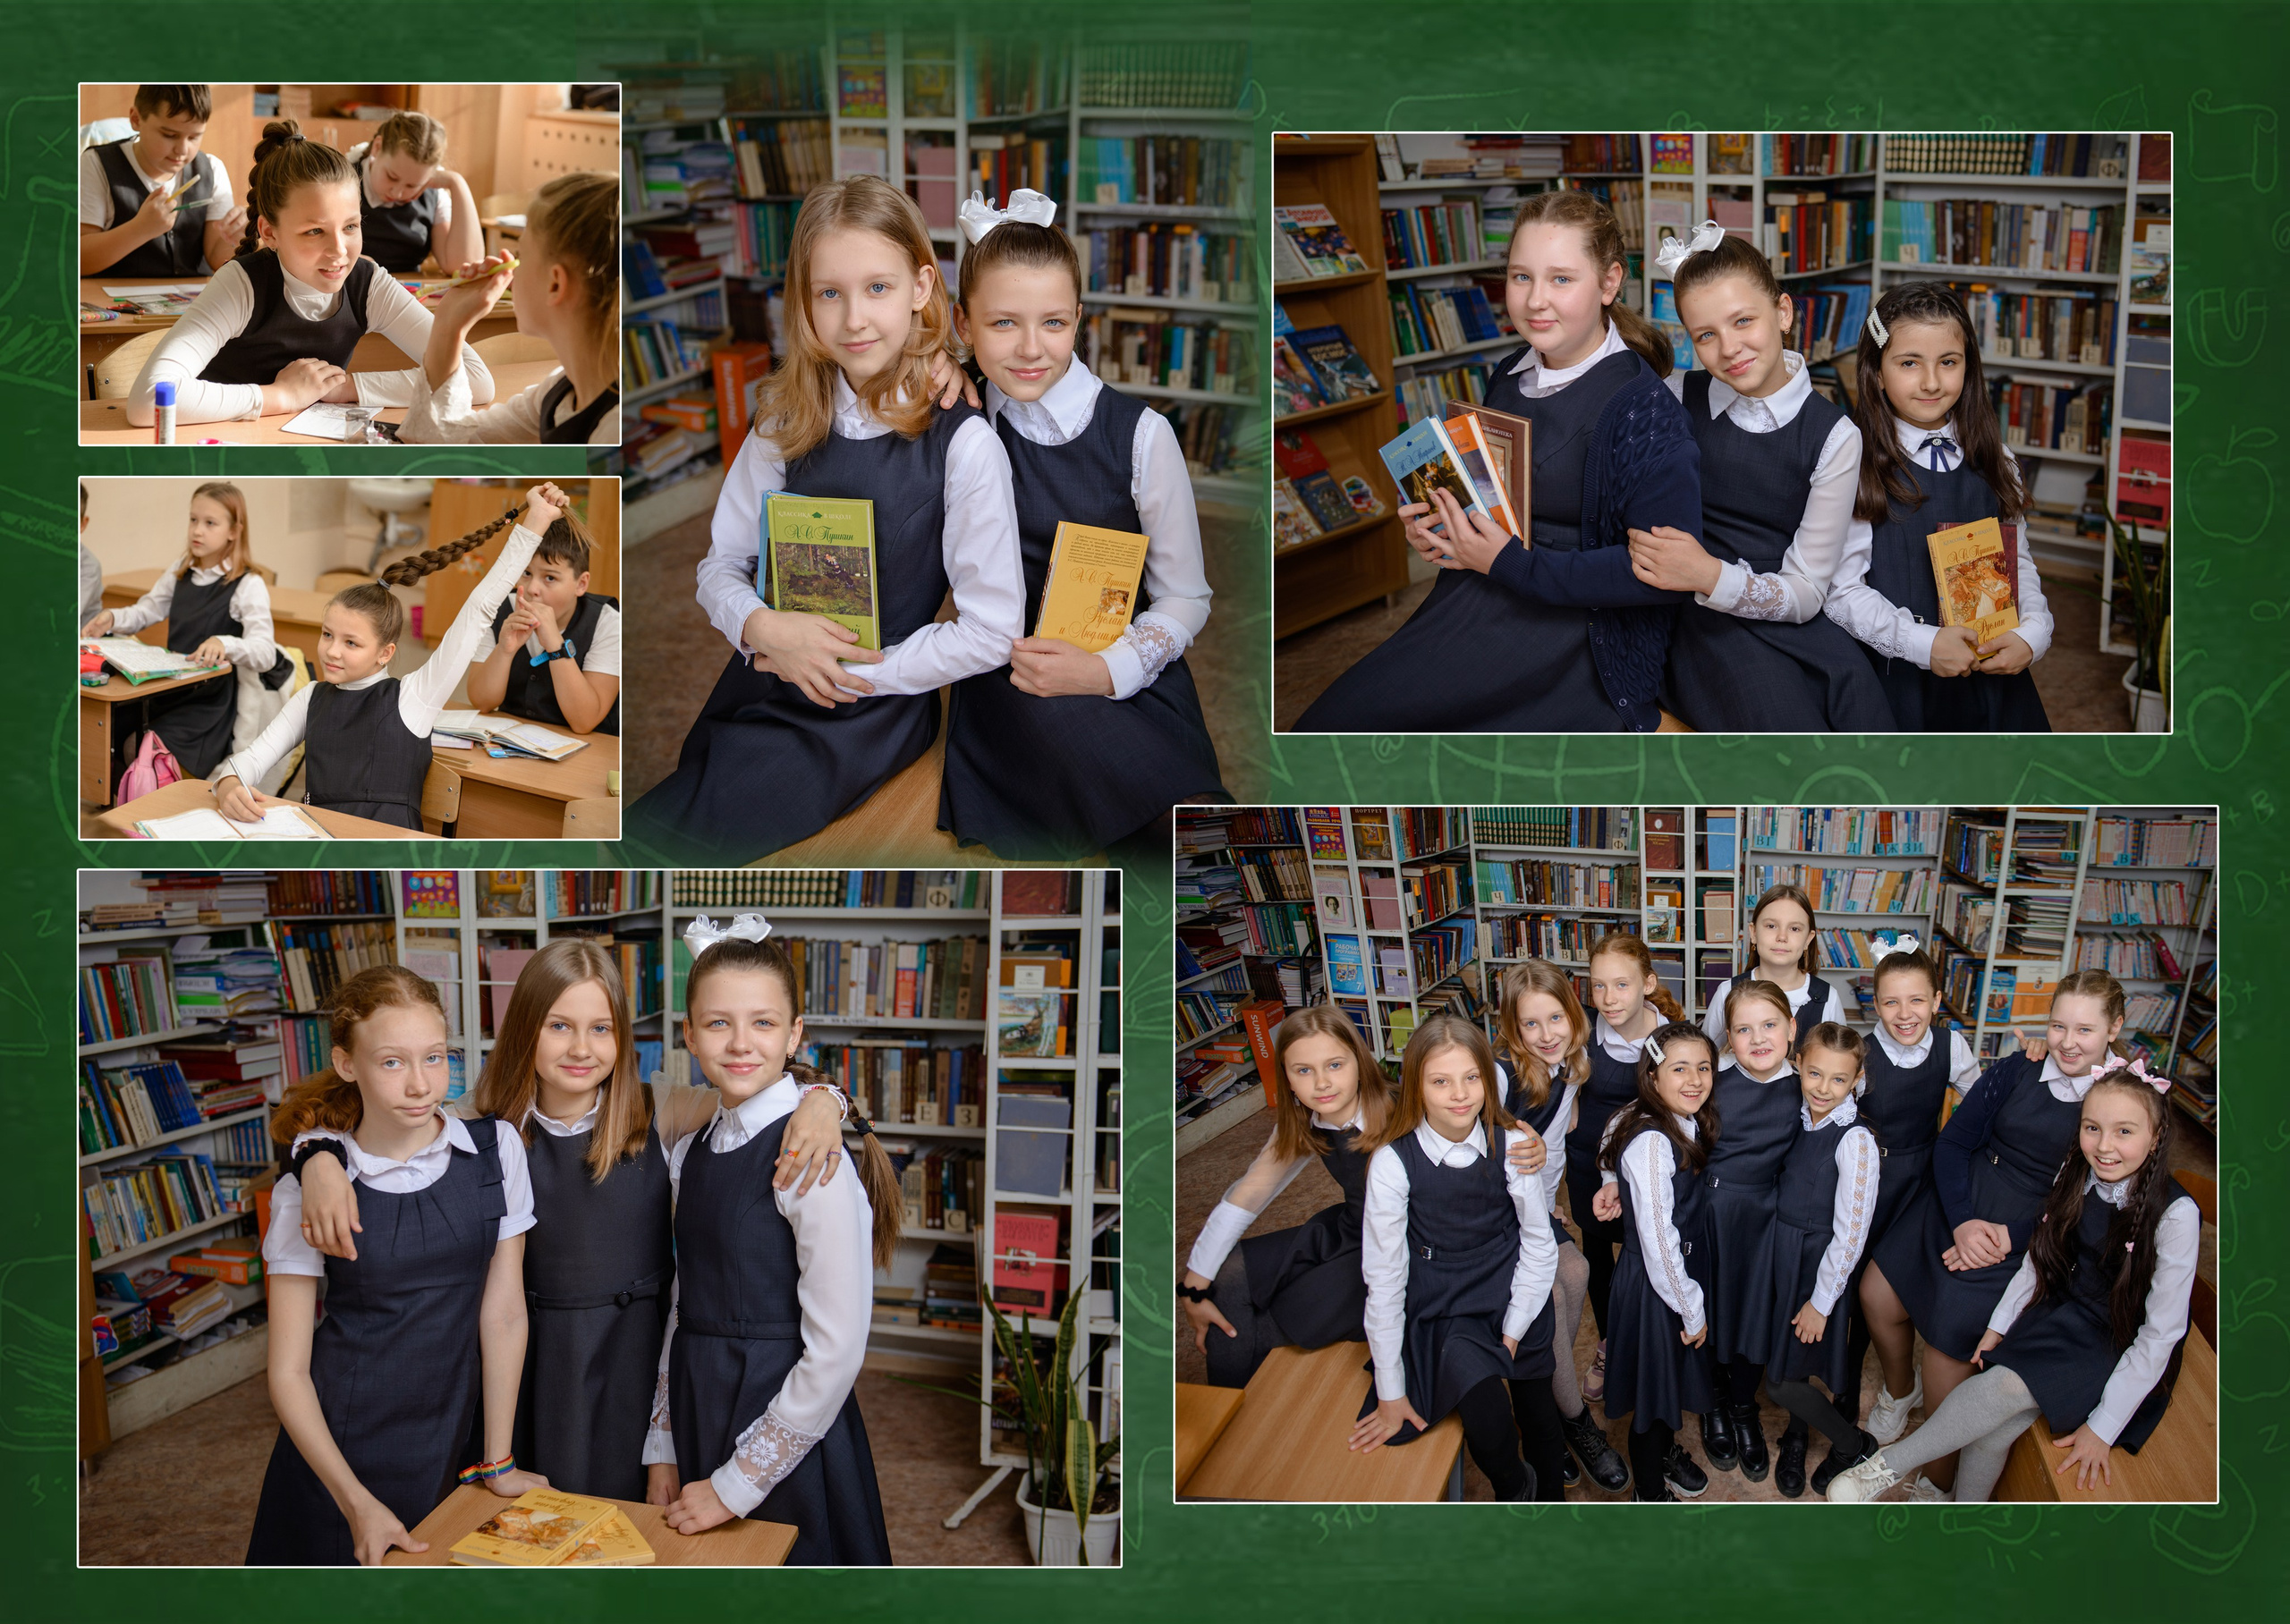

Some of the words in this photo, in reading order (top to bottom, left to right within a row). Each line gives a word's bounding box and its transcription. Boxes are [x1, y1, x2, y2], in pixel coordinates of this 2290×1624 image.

[777, 511, 811, 519] КЛАССИКА
[814, 525, 854, 544] Пушкин
[1969, 544, 1997, 558] Пушкин
[1098, 571, 1132, 589] Пушкин
[1083, 605, 1124, 629] Руслан
[1058, 627, 1065, 635] и
[1973, 618, 2006, 636] Руслан
[1614, 841, 1624, 850] Ф
[929, 891, 946, 907] Ф
[1495, 892, 1502, 901] Ч
[1562, 950, 1568, 959] В
[1356, 982, 1362, 991] 7
[1251, 1014, 1269, 1059] SUNWIND
[920, 1105, 932, 1121] Е
[948, 1212, 962, 1227] С
